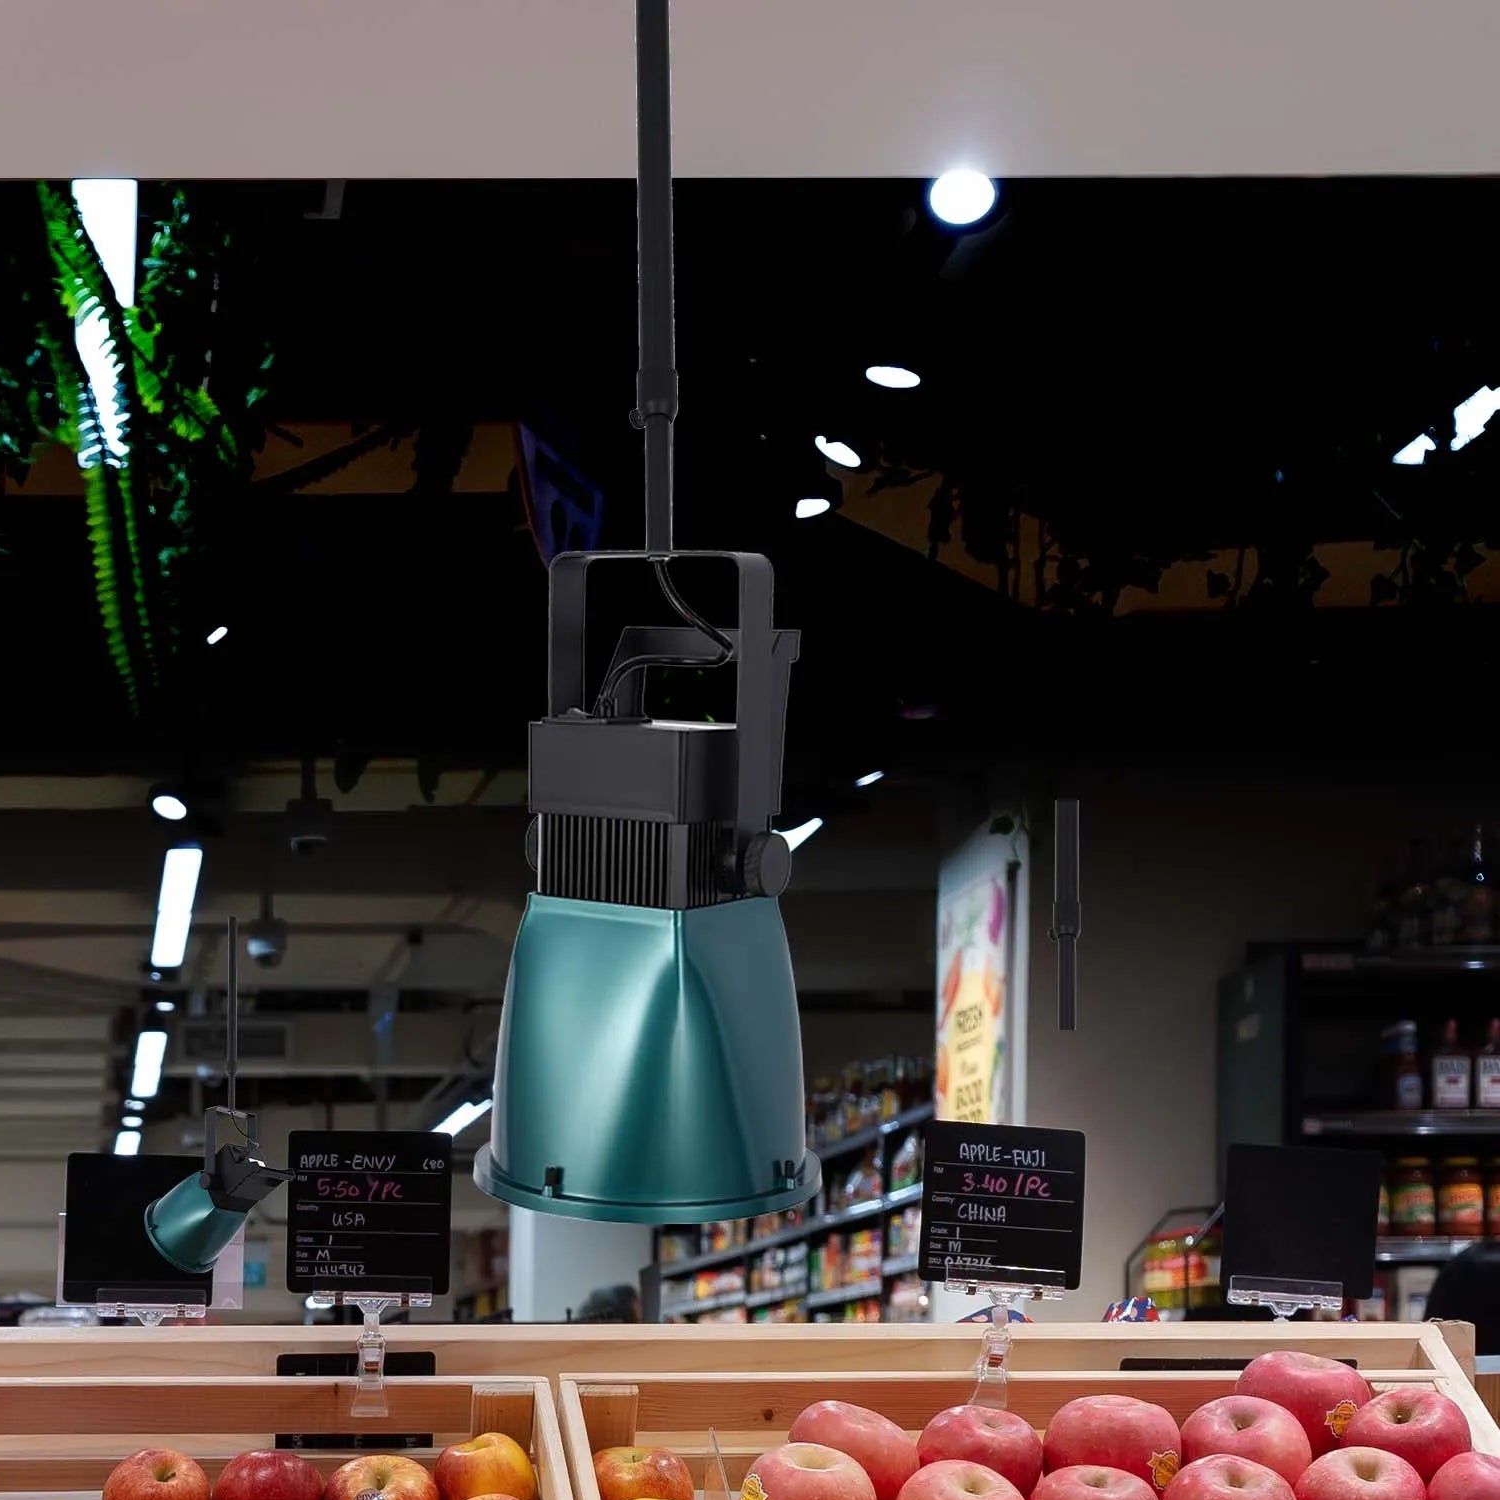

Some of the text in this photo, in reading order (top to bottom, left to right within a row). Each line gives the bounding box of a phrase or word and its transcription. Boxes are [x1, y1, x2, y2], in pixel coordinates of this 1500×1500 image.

[300, 1153, 339, 1169] APPLE
[961, 1172, 1008, 1193] 3.40
[332, 1212, 366, 1227] USA
[957, 1203, 1007, 1222] CHINA
[316, 1249, 331, 1261] M
[313, 1264, 366, 1277] 144942
